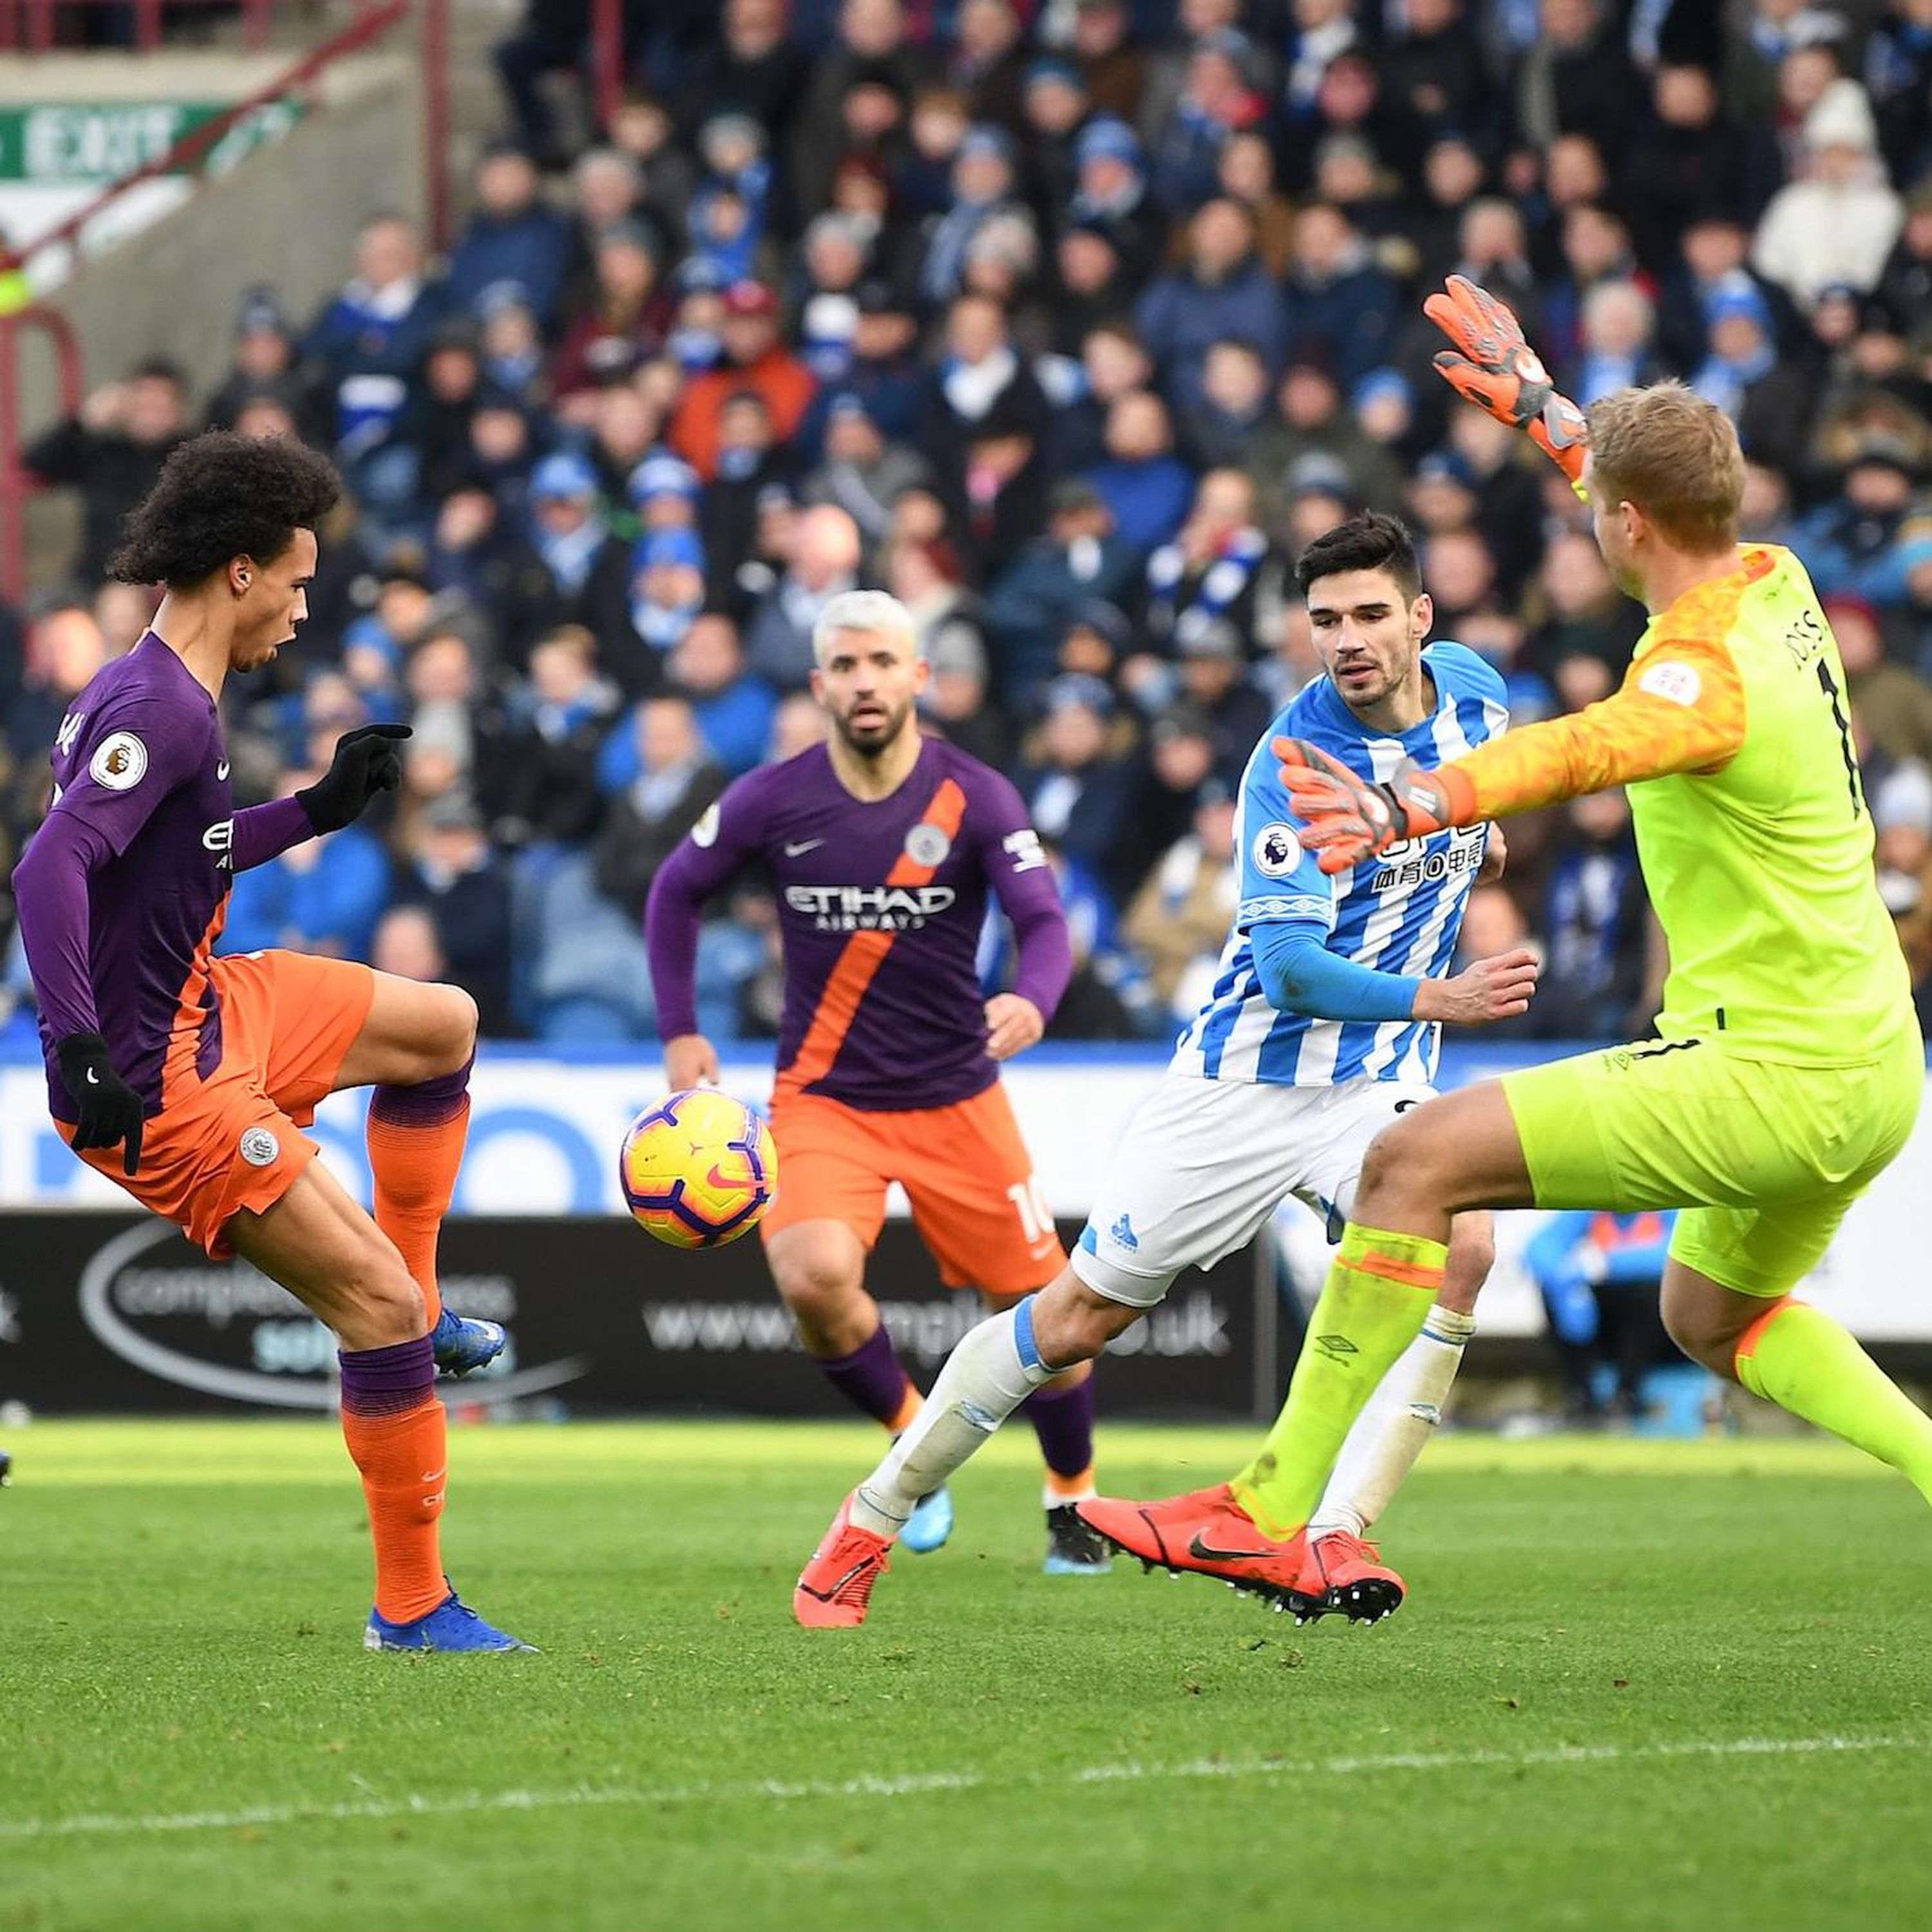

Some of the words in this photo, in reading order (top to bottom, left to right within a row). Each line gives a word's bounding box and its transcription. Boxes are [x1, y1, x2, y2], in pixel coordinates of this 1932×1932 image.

[24, 107, 179, 176] EXIT
[784, 886, 956, 915] ETIHAD
[815, 913, 926, 931] AIRWAYS
